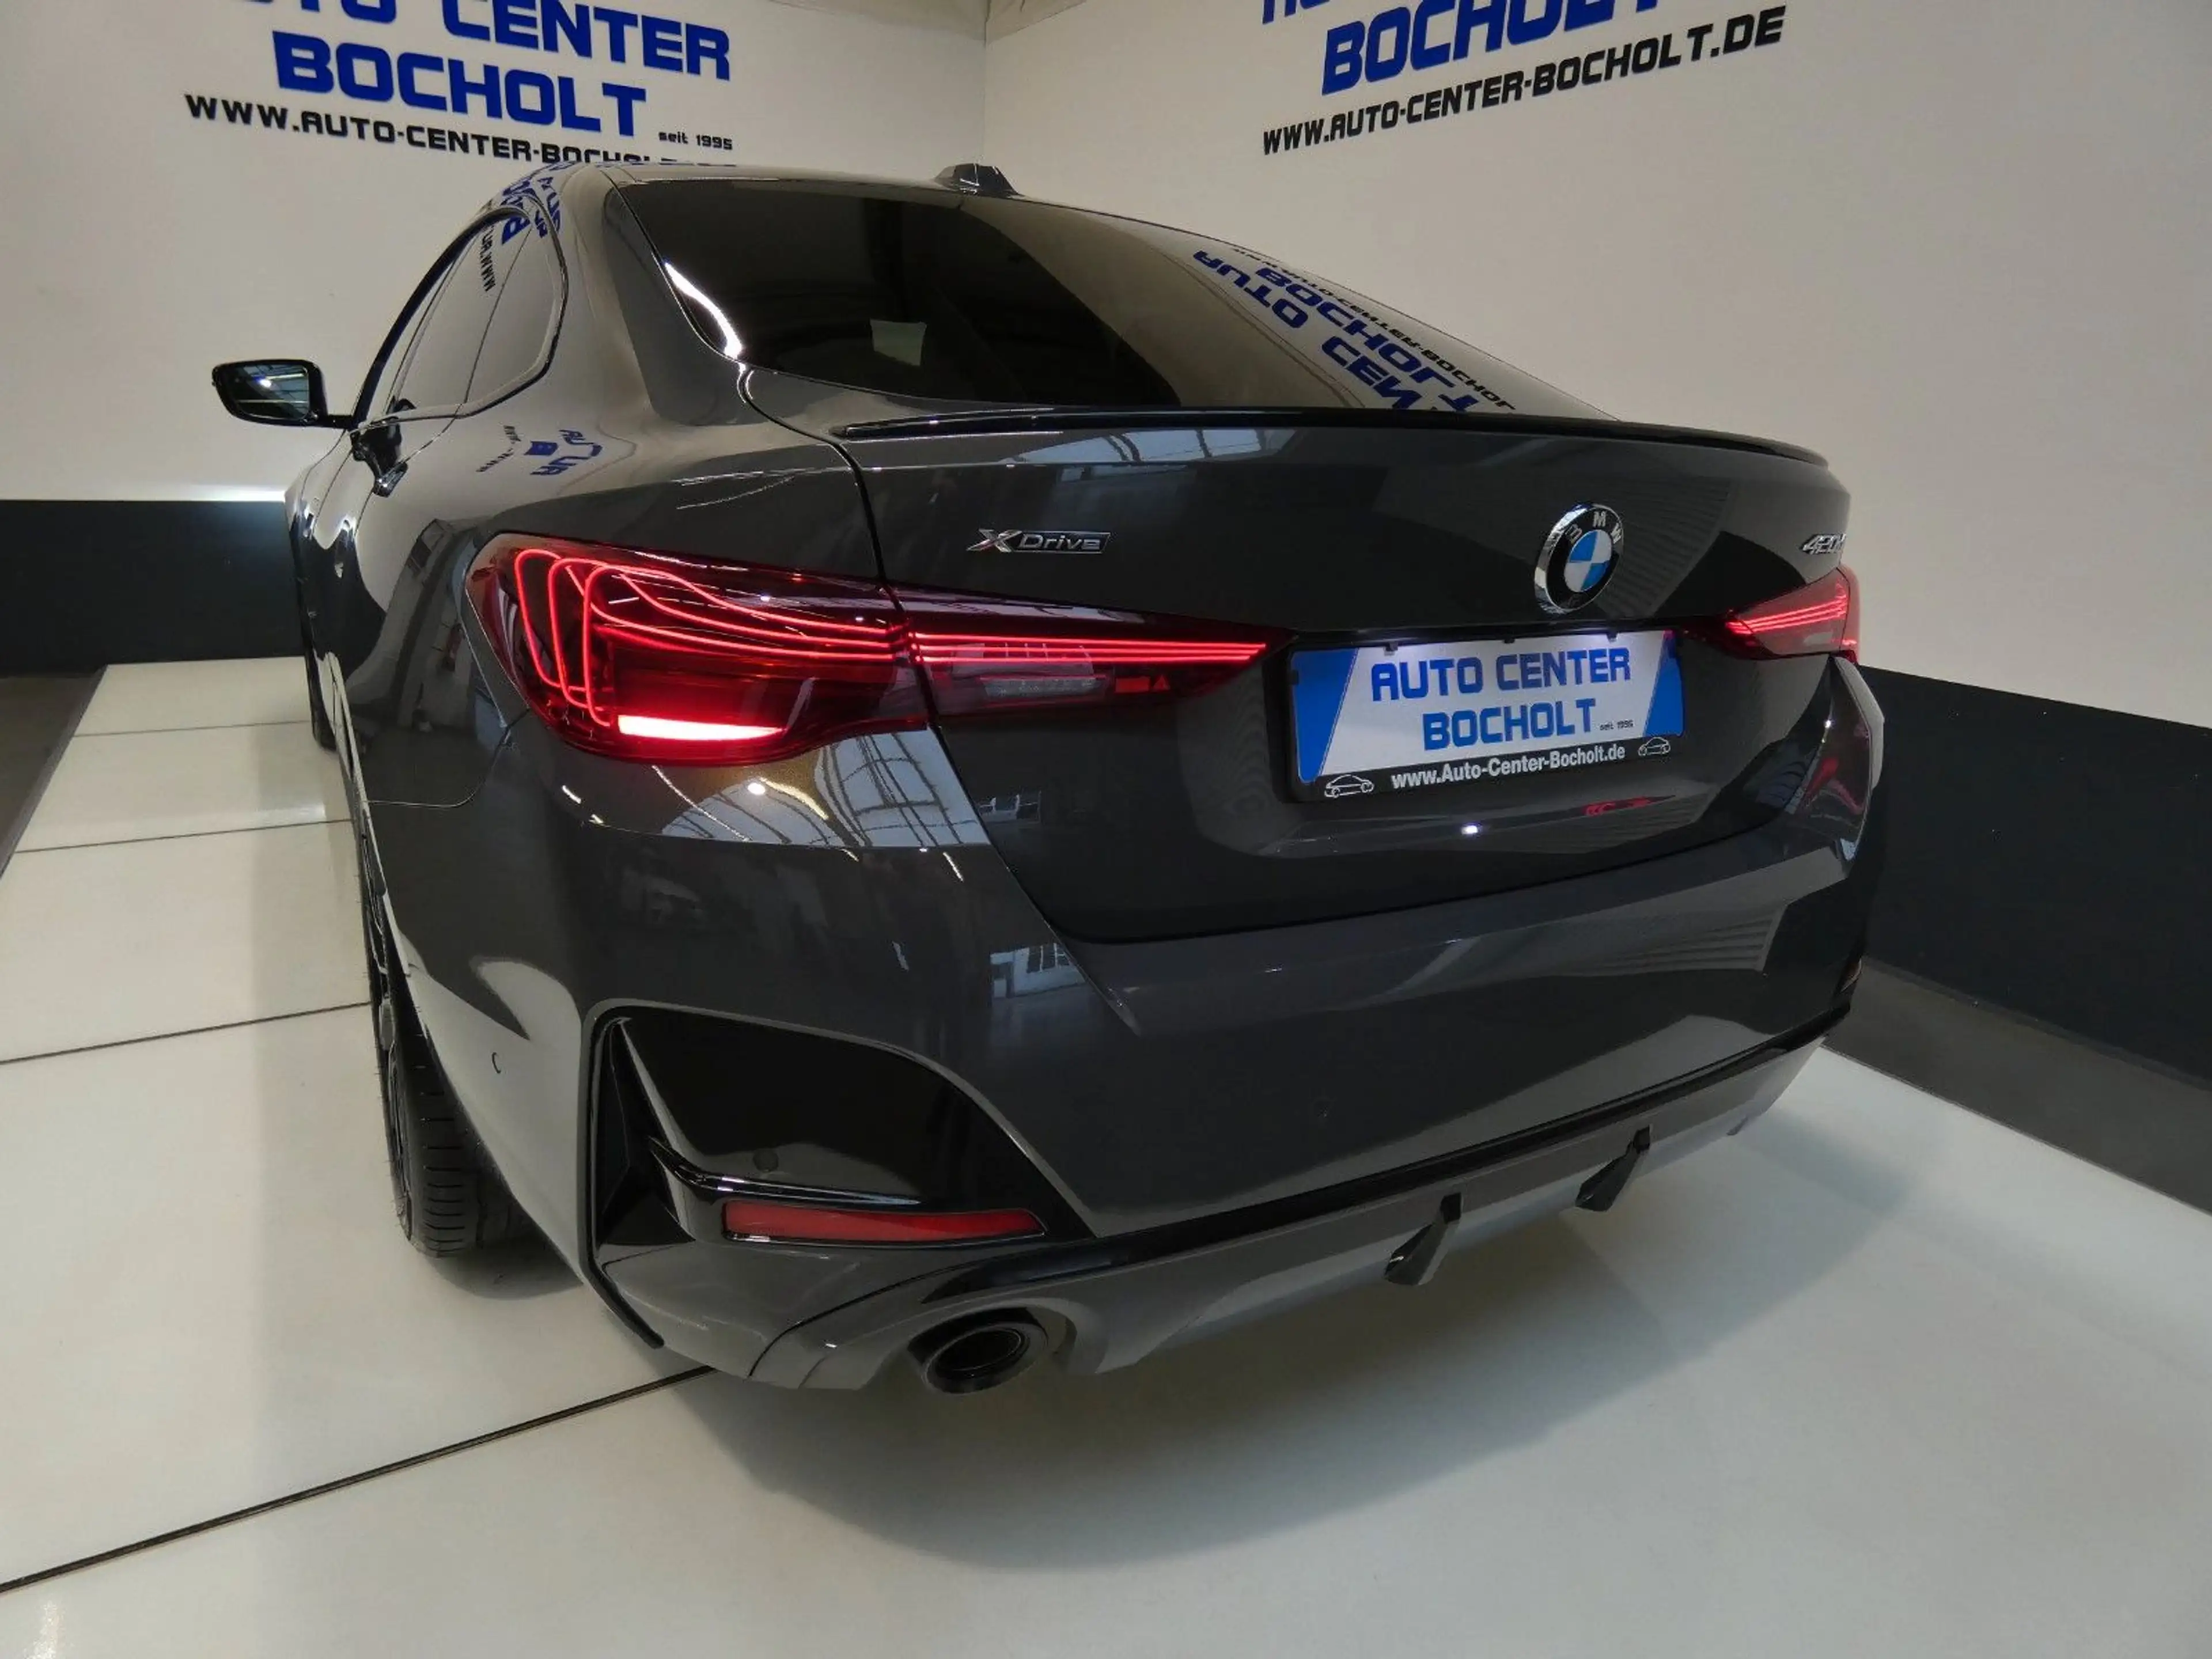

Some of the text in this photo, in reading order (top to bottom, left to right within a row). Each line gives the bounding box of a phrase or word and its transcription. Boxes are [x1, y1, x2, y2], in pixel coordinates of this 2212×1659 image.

[442, 0, 731, 81] CENTER
[1321, 0, 1659, 95] BOCHO
[272, 30, 647, 137] BOCHOLT
[1263, 5, 1786, 155] WWW.AUTO-CENTER-BOCHOLT.DE
[658, 131, 733, 150] seit 1995
[1565, 510, 1622, 544] BMW
[1371, 647, 1631, 702] AUTO CENTER
[1423, 698, 1596, 751] BOCHOLT
[1391, 744, 1626, 789] www.Auto-Center-Bocholt.de
